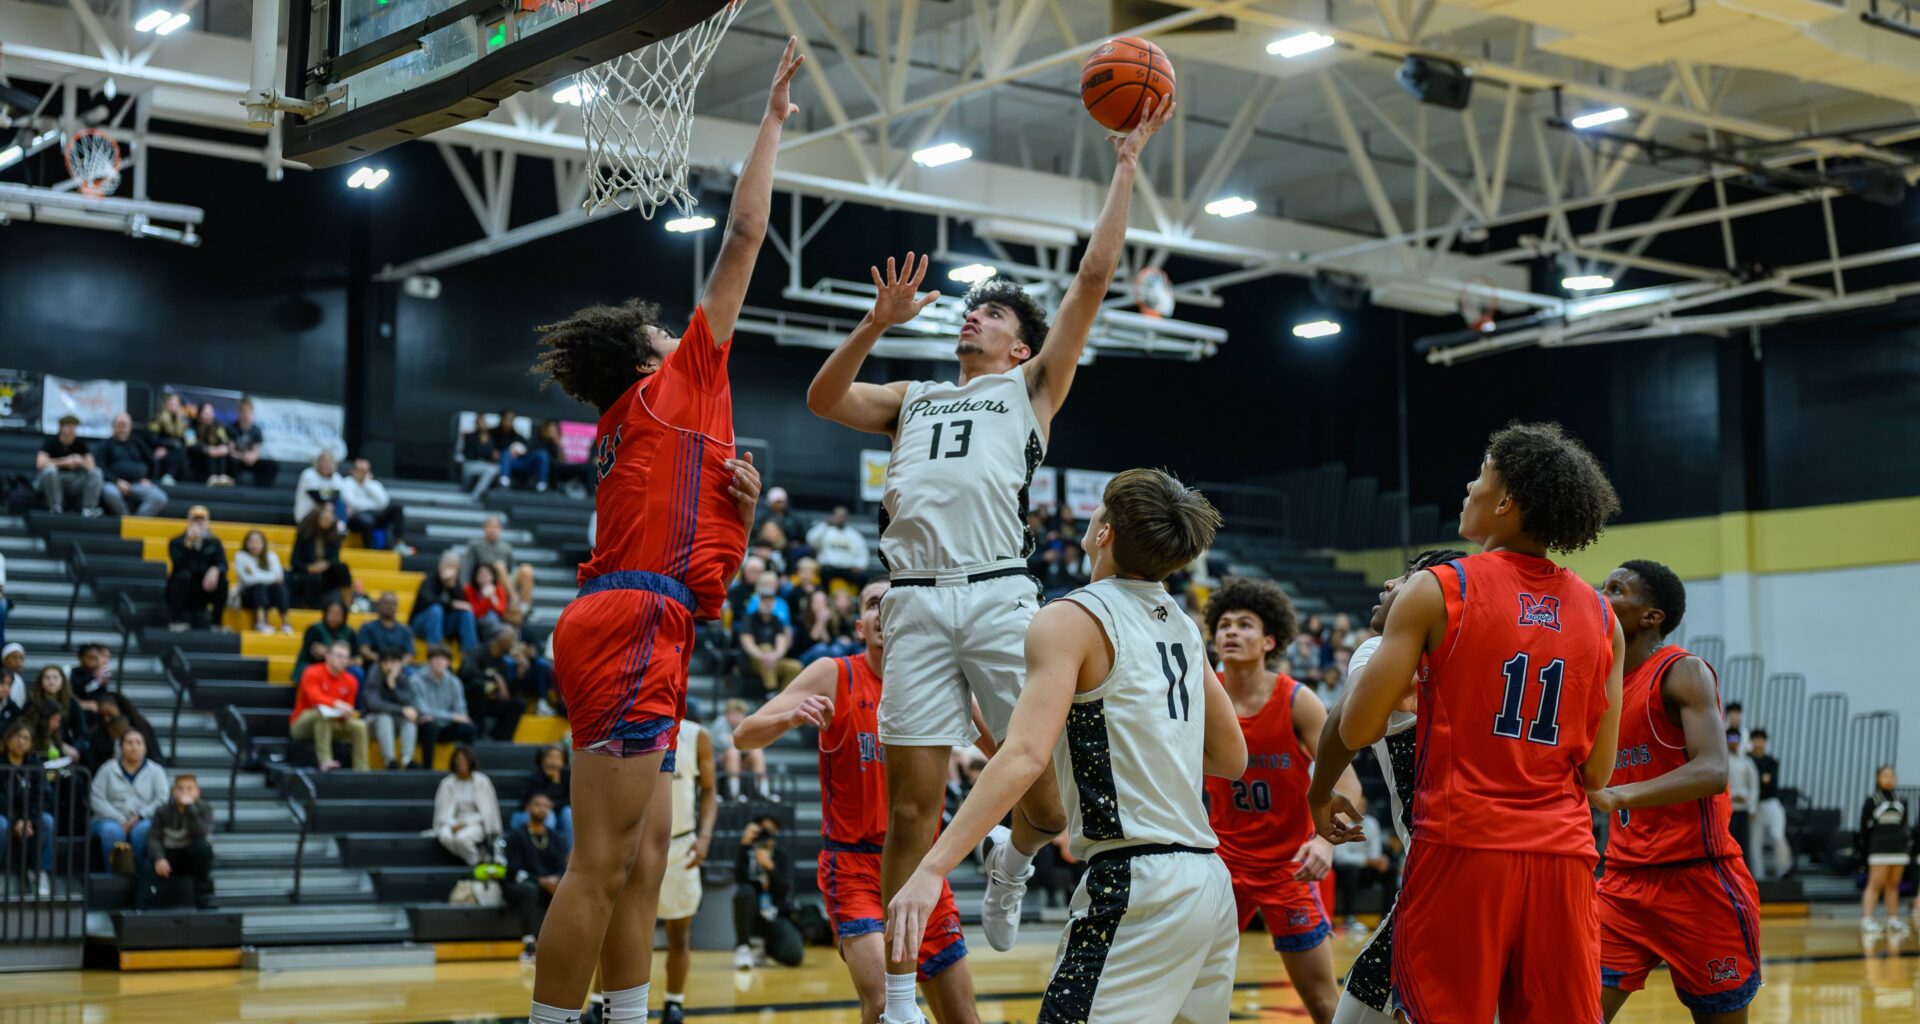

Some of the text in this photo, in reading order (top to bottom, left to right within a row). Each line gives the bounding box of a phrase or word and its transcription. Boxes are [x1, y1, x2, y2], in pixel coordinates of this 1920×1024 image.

[905, 397, 1009, 424] Panthers
[929, 419, 973, 460] 13
[1156, 641, 1189, 722] 11
[1493, 651, 1565, 746] 11
[1231, 779, 1271, 813] 20
